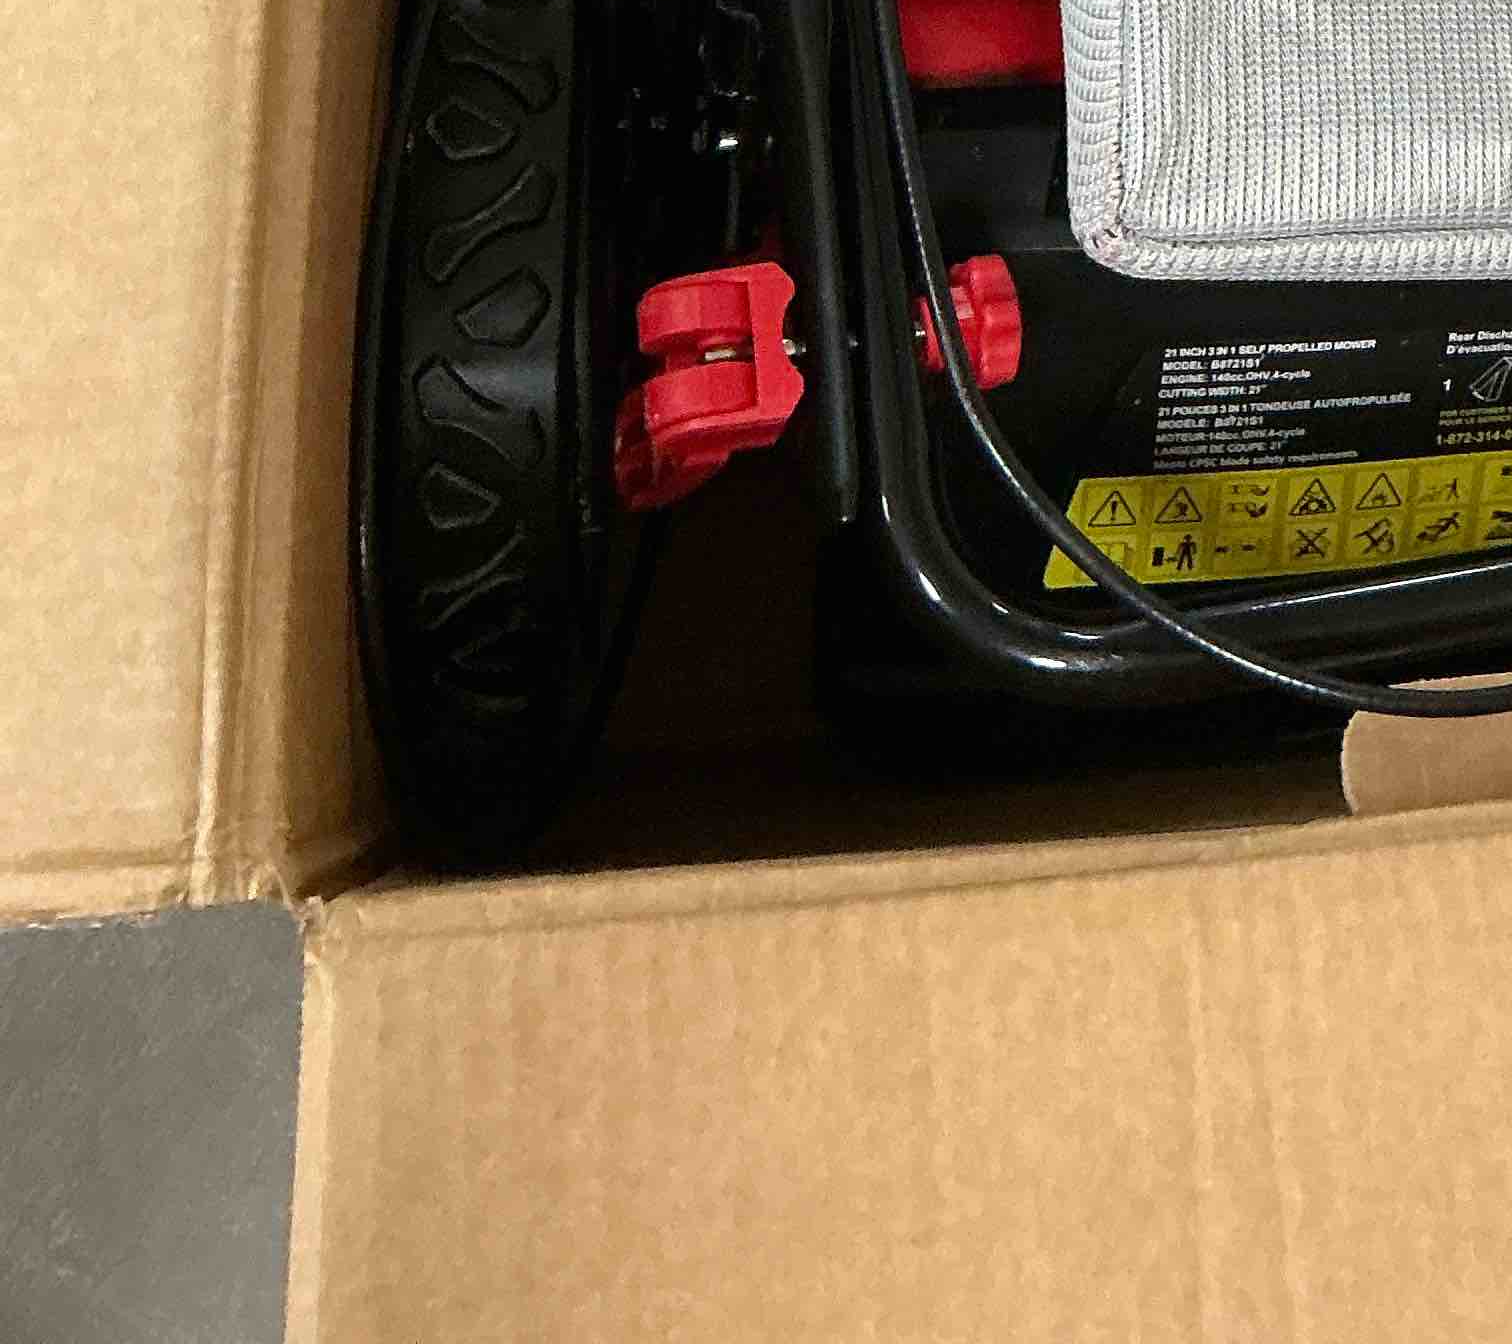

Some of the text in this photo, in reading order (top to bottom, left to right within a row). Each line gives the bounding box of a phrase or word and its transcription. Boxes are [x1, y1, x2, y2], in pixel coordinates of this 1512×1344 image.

[1448, 331, 1475, 342] Rear
[1164, 349, 1177, 359] 21
[1179, 347, 1206, 357] INCH
[1238, 344, 1265, 355] SELF
[1267, 341, 1332, 353] PROPELLED
[1334, 338, 1377, 350] MOWER
[1442, 379, 1452, 391] 1
